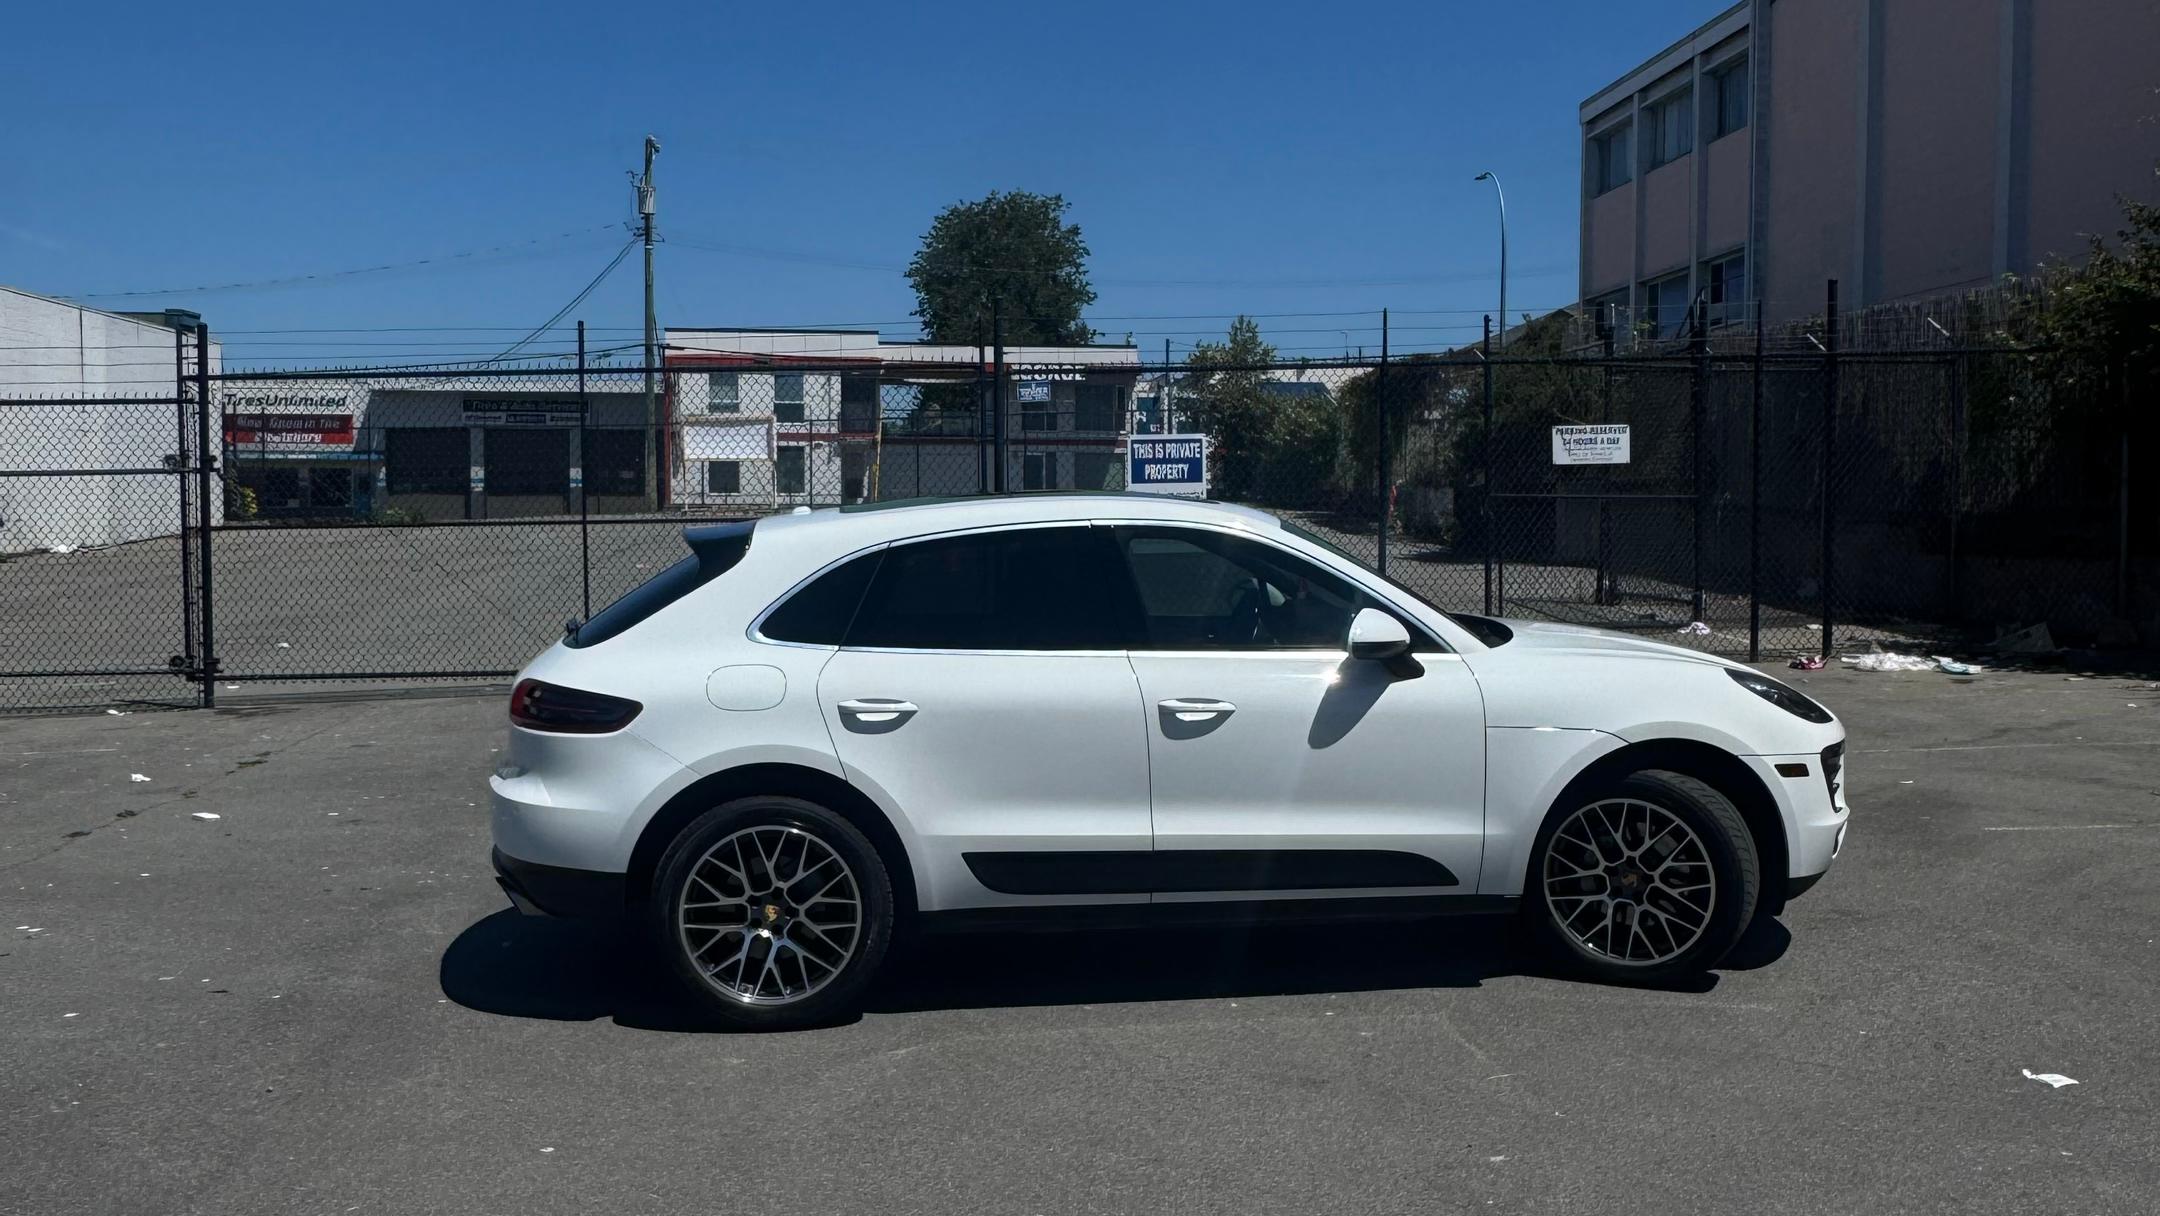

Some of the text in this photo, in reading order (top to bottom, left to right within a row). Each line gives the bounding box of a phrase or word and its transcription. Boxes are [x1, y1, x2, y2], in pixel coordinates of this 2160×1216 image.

[1133, 442, 1201, 459] THIS IS PRIVATE
[1145, 463, 1190, 480] PROPERTY
